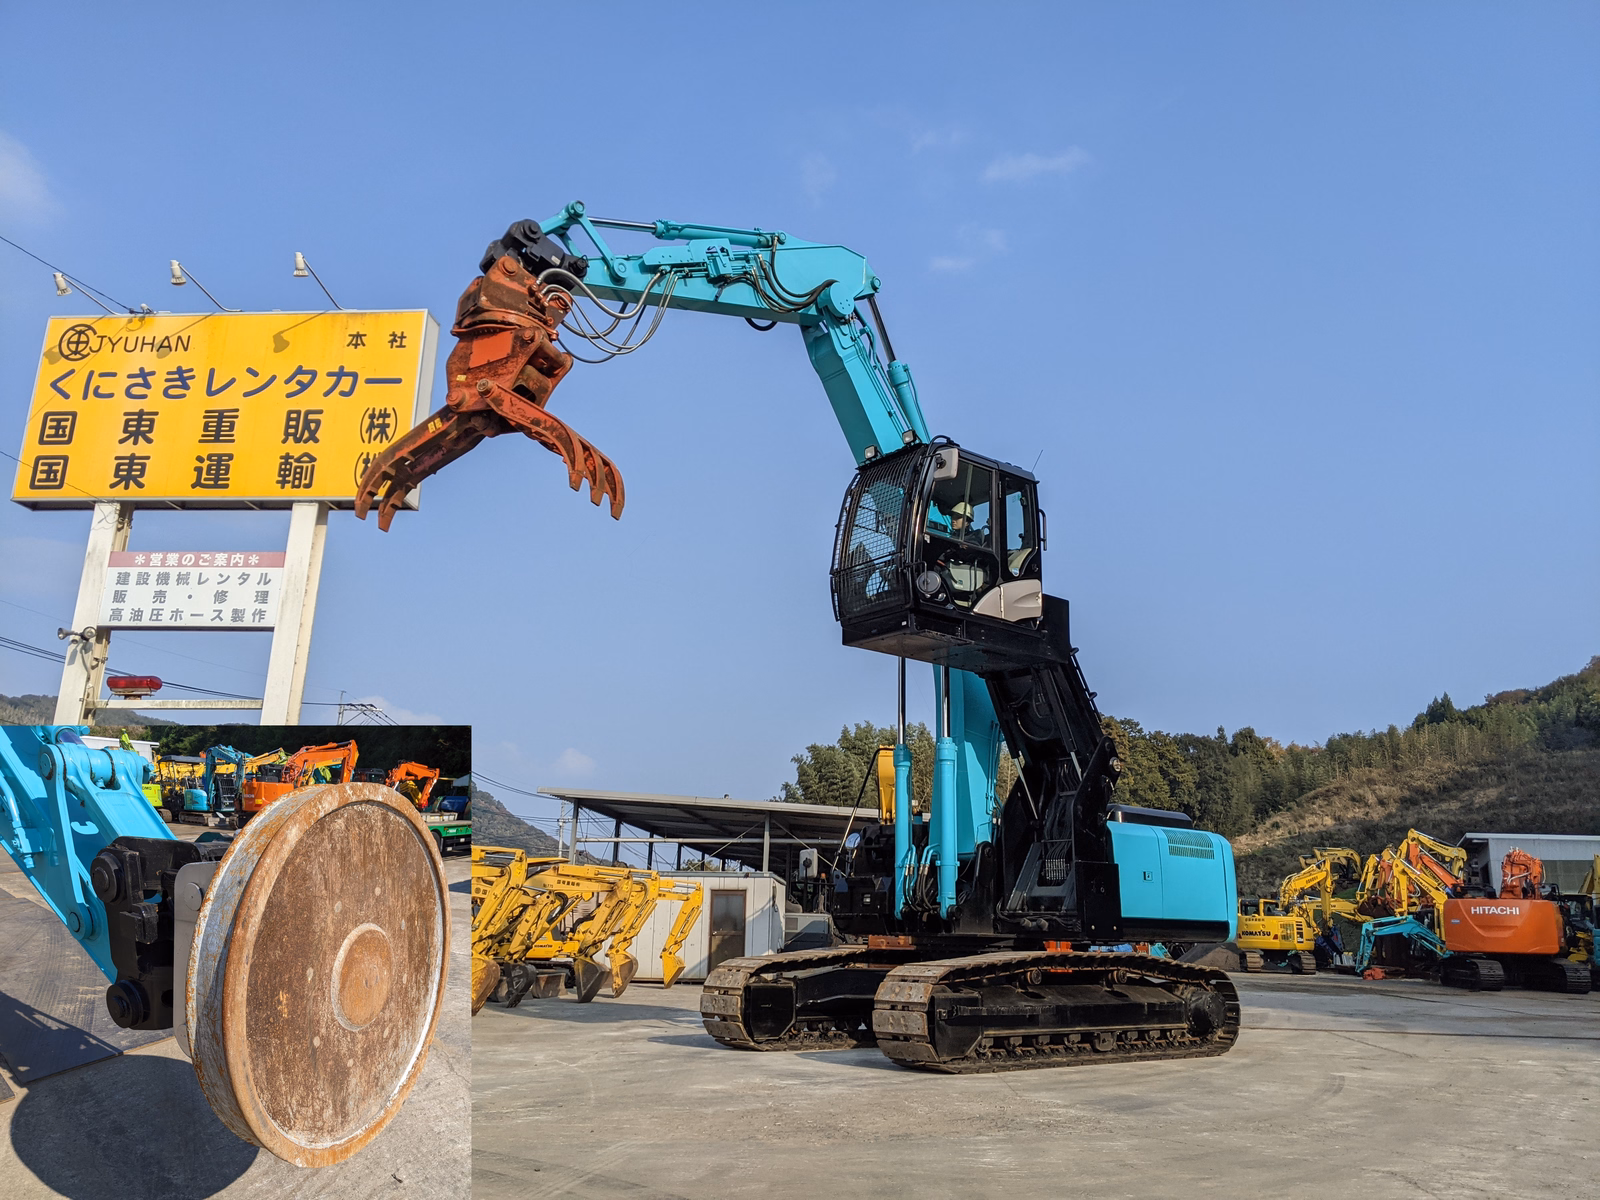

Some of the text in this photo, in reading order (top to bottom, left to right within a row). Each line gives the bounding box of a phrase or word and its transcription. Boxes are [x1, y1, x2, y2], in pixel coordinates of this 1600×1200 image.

[89, 334, 191, 353] JYUHAN
[346, 331, 408, 349] 本社
[49, 365, 403, 400] くにさきレンタカー
[115, 571, 272, 586] 建設機械レンタル
[108, 607, 267, 623] 高油圧ホース製作
[1471, 906, 1520, 915] HITACHI
[1241, 929, 1271, 937] KOMATSU
